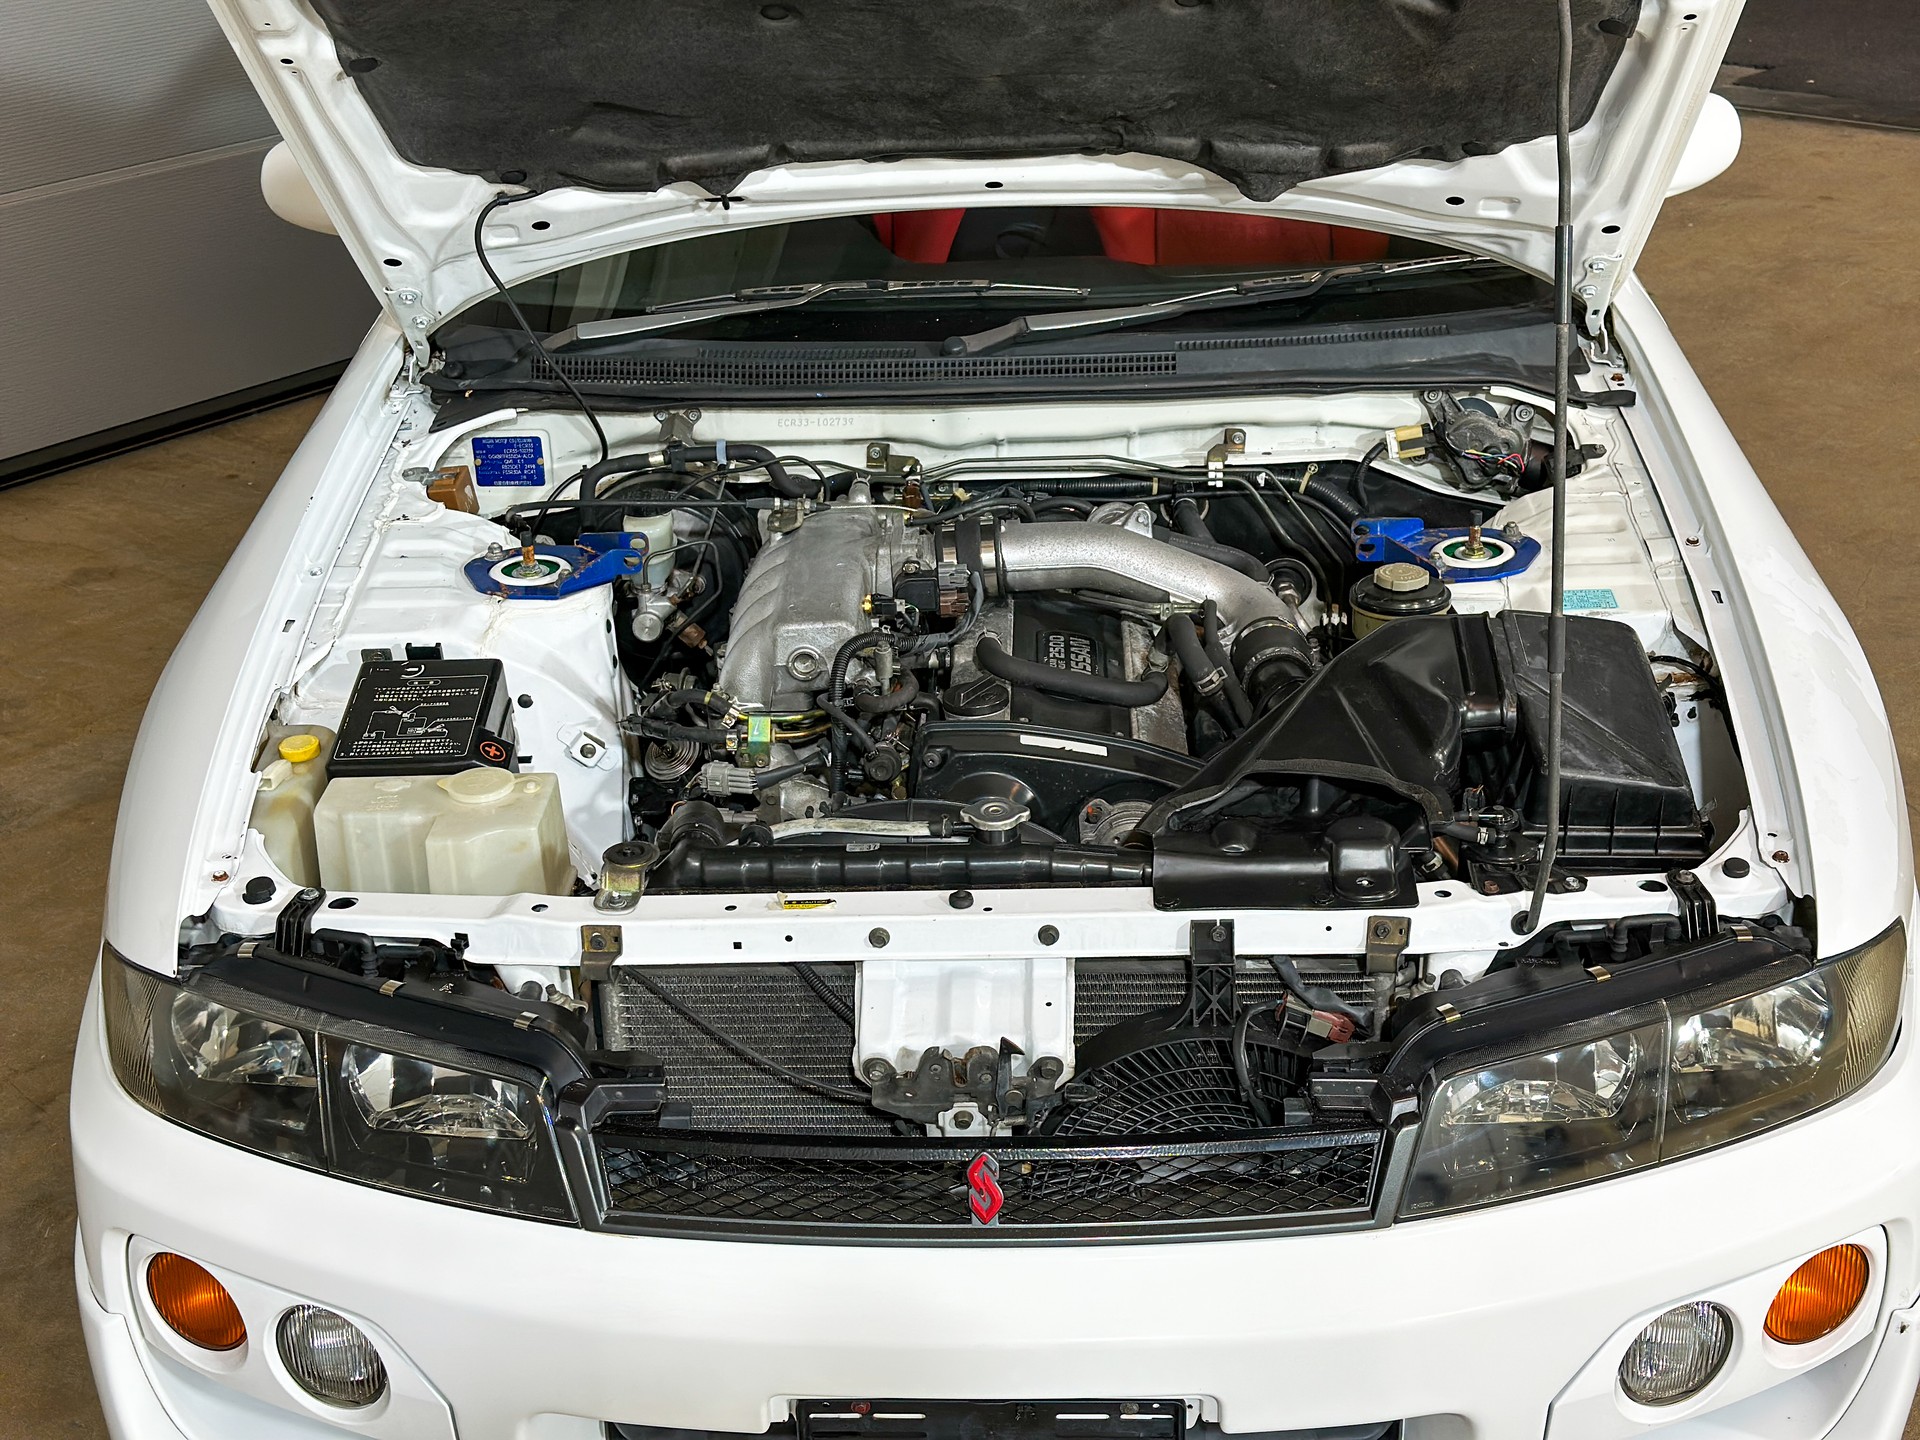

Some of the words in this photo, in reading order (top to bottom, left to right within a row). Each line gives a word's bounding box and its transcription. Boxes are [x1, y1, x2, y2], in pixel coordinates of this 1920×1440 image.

[777, 417, 854, 427] ECR33-102739
[1049, 635, 1065, 659] 2500
[1070, 636, 1092, 675] ISSAN
